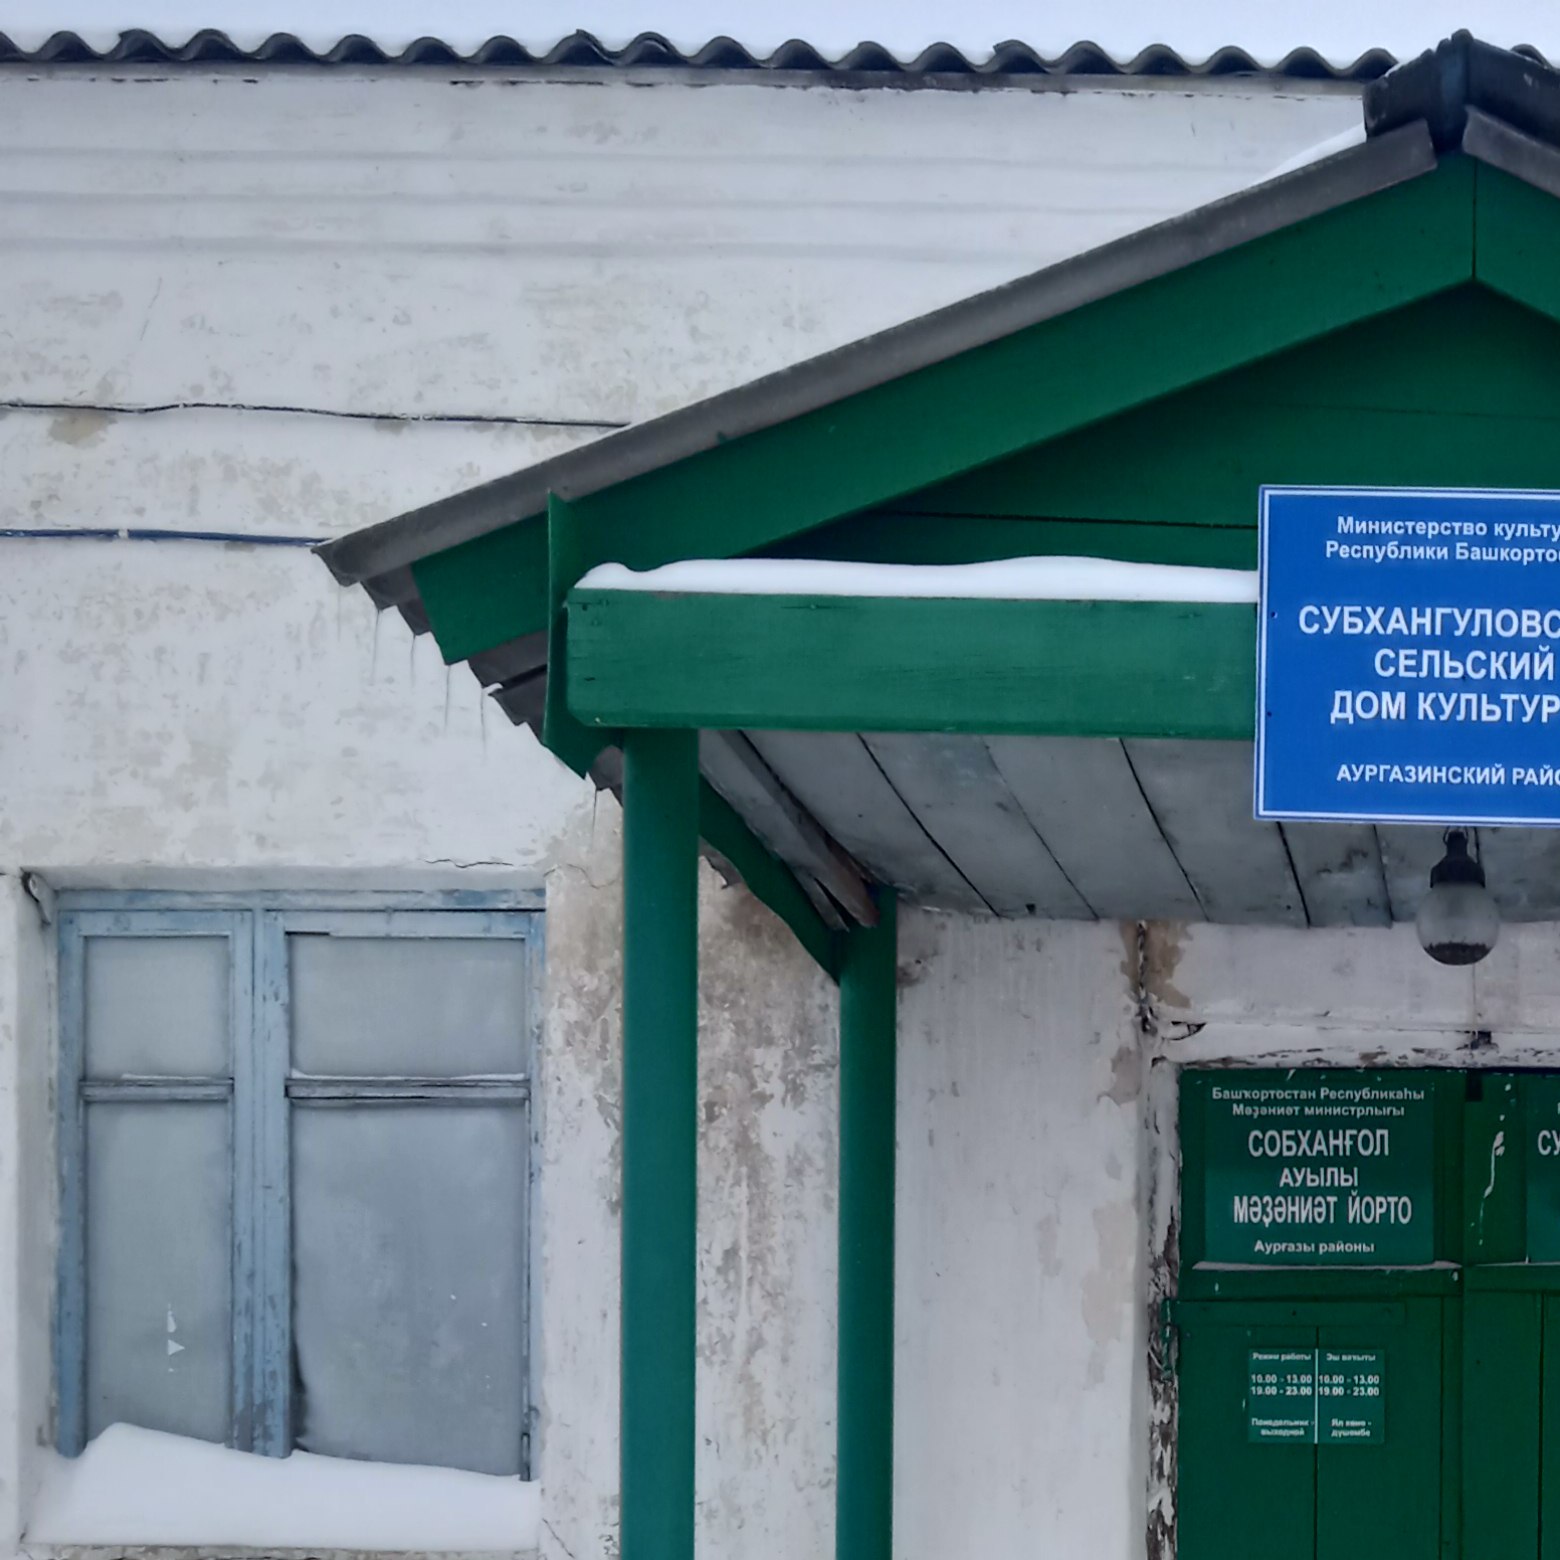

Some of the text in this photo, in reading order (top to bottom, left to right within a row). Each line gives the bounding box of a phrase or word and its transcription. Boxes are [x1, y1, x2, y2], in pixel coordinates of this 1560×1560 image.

[1337, 515, 1488, 539] Министерство
[1325, 541, 1449, 563] Республики
[1374, 645, 1554, 680] СЕЛЬСКИЙ
[1330, 690, 1406, 724] ДОМ
[1336, 762, 1506, 785] АУРГАЗИНСКИЙ
[1320, 1087, 1424, 1102] Республикаһы
[1248, 1129, 1389, 1157] СОБХАНҒОЛ
[1279, 1167, 1358, 1188] АУЫЛЫ
[1233, 1190, 1412, 1227] МӘҘӘНИӘТ ЙОРТО
[1319, 1241, 1374, 1255] районы
[1253, 1352, 1311, 1362] Режим работы
[1251, 1374, 1277, 1383] 10.00
[1286, 1375, 1312, 1384] 13.00
[1319, 1375, 1344, 1384] 10.00
[1354, 1375, 1379, 1384] 13.00
[1251, 1386, 1277, 1395] 19.00
[1286, 1386, 1312, 1396] 23.00
[1319, 1387, 1344, 1396] 19.00
[1353, 1387, 1379, 1396] 23.00
[1252, 1418, 1308, 1427] Понедельник
[1261, 1428, 1304, 1436] выходной
